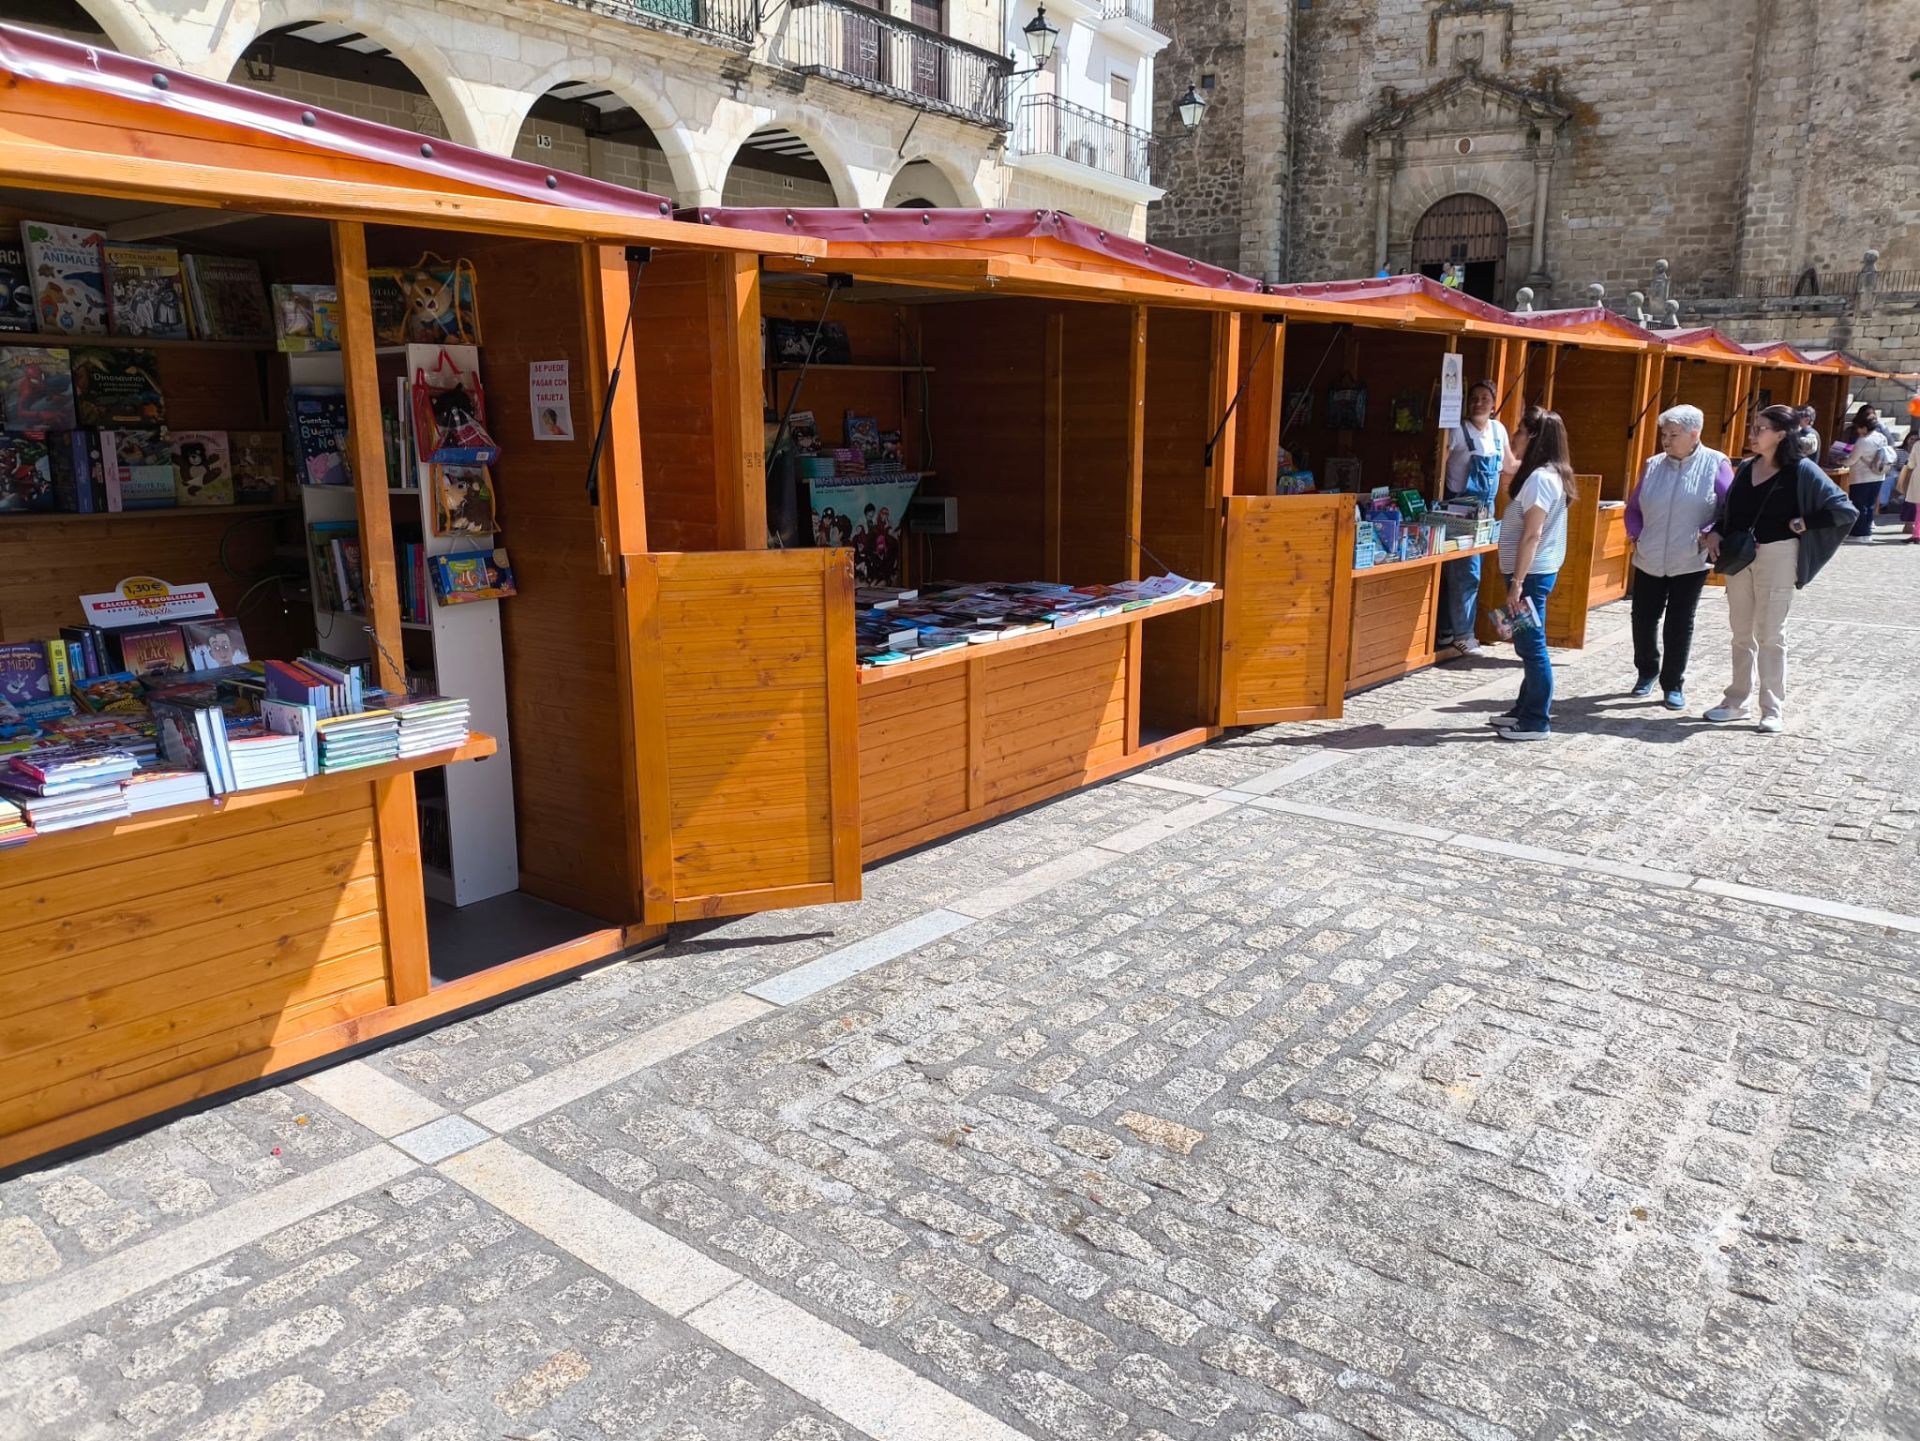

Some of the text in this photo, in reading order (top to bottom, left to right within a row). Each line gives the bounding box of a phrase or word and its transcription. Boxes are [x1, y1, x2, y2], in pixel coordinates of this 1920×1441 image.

[43, 251, 101, 267] ANIMALES
[535, 364, 564, 373] SE PUEDE
[532, 379, 552, 387] PAGAR
[537, 393, 564, 401] TARJETA
[148, 593, 198, 602] PROBLEMAS
[138, 607, 172, 618] ANAYA
[137, 646, 173, 661] BLACK
